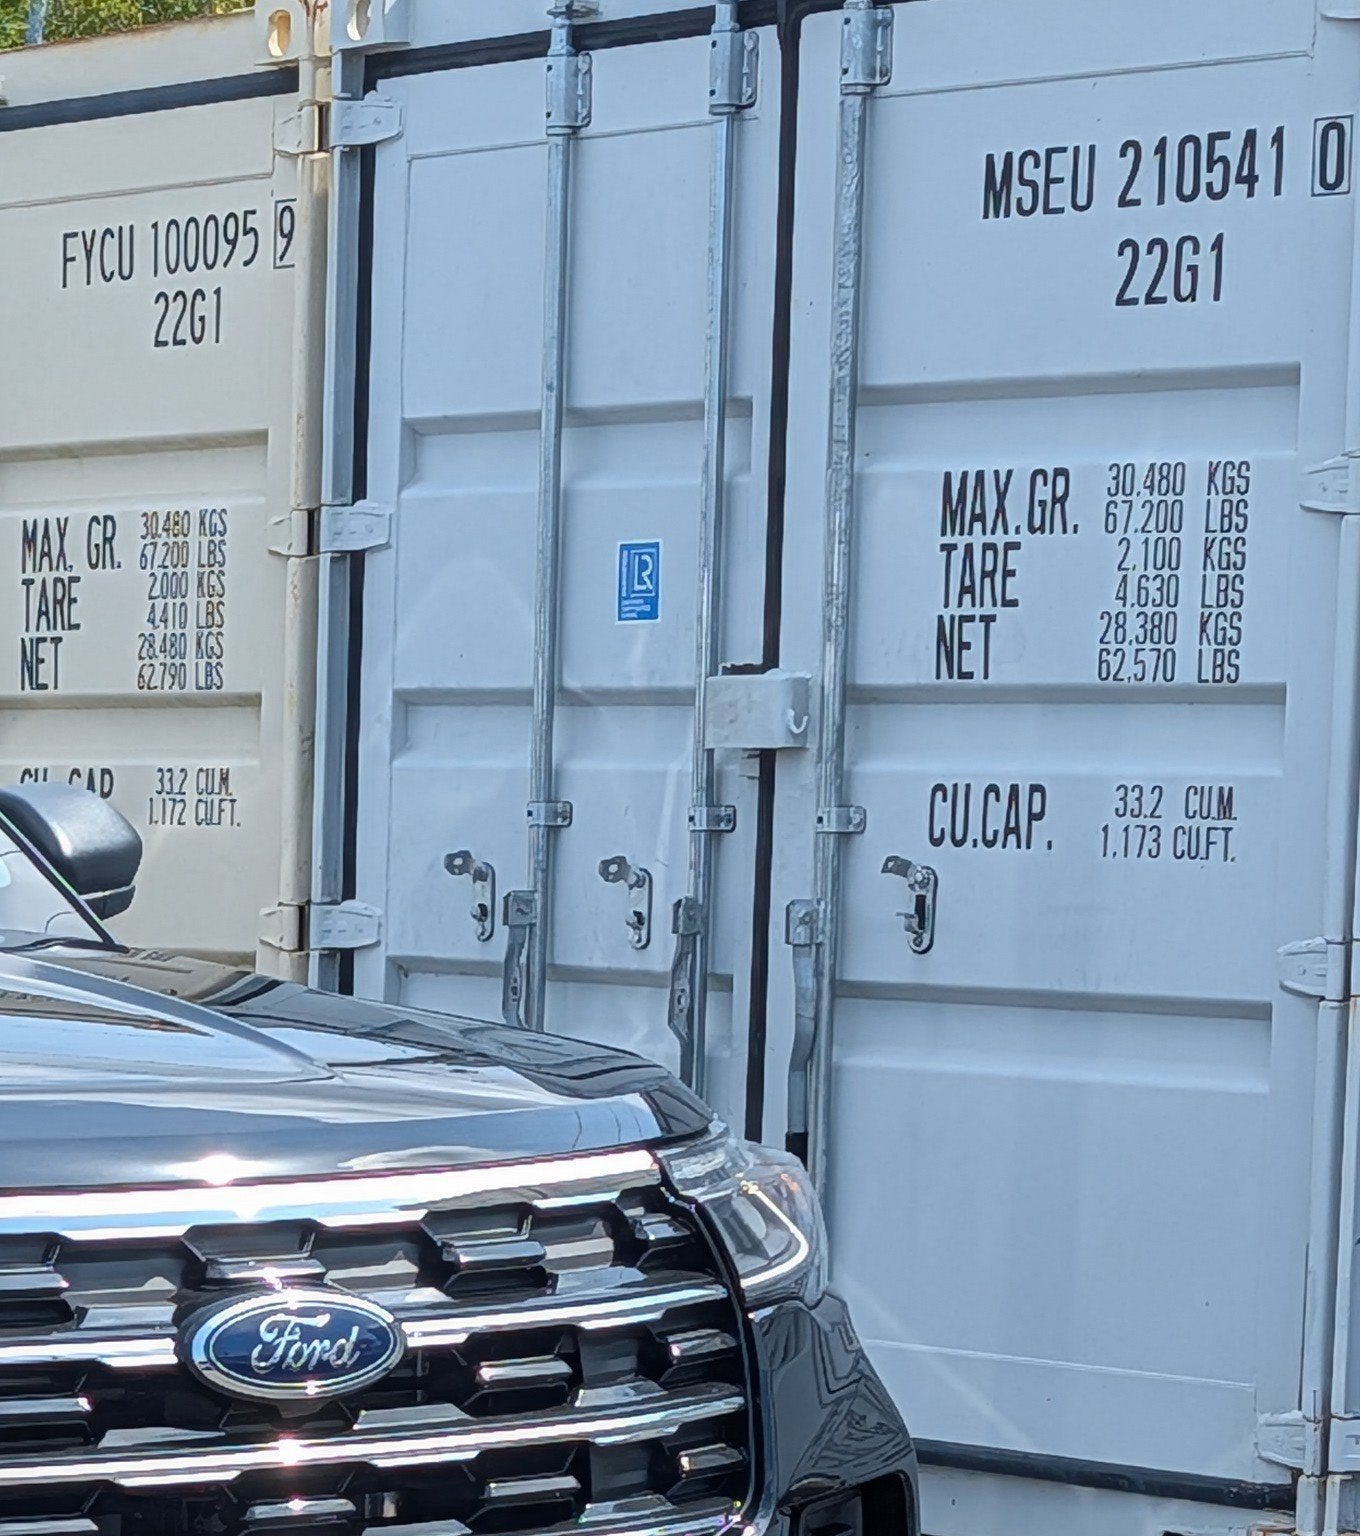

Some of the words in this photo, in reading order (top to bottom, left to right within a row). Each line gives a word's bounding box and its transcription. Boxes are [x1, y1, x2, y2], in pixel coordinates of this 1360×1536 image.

[982, 144, 1096, 219] MSEU
[1118, 126, 1285, 207] 210541
[1319, 121, 1346, 191] 0
[62, 224, 134, 288] FYCU
[151, 209, 259, 278] 100095
[279, 205, 295, 262] 9
[1115, 232, 1224, 306] 22G1
[154, 286, 222, 347] 22G1
[1207, 460, 1250, 496] KGS
[199, 508, 227, 537] KGS
[1205, 498, 1248, 534] LBS
[87, 515, 121, 570] GR.
[197, 539, 226, 568] LBS
[1203, 536, 1246, 572] KGS
[196, 570, 225, 598] KGS
[940, 541, 1021, 609] TARE
[1200, 573, 1244, 609] LBS
[22, 576, 81, 632] TARE
[196, 600, 225, 629] LBS
[195, 631, 224, 659] KGS
[935, 613, 997, 680] NET
[1198, 611, 1242, 647] KGS
[21, 637, 63, 691] NET
[195, 661, 224, 690] LBS
[1197, 648, 1240, 684] LBS
[1114, 784, 1163, 819] 33.2
[251, 1313, 359, 1374] Ford
